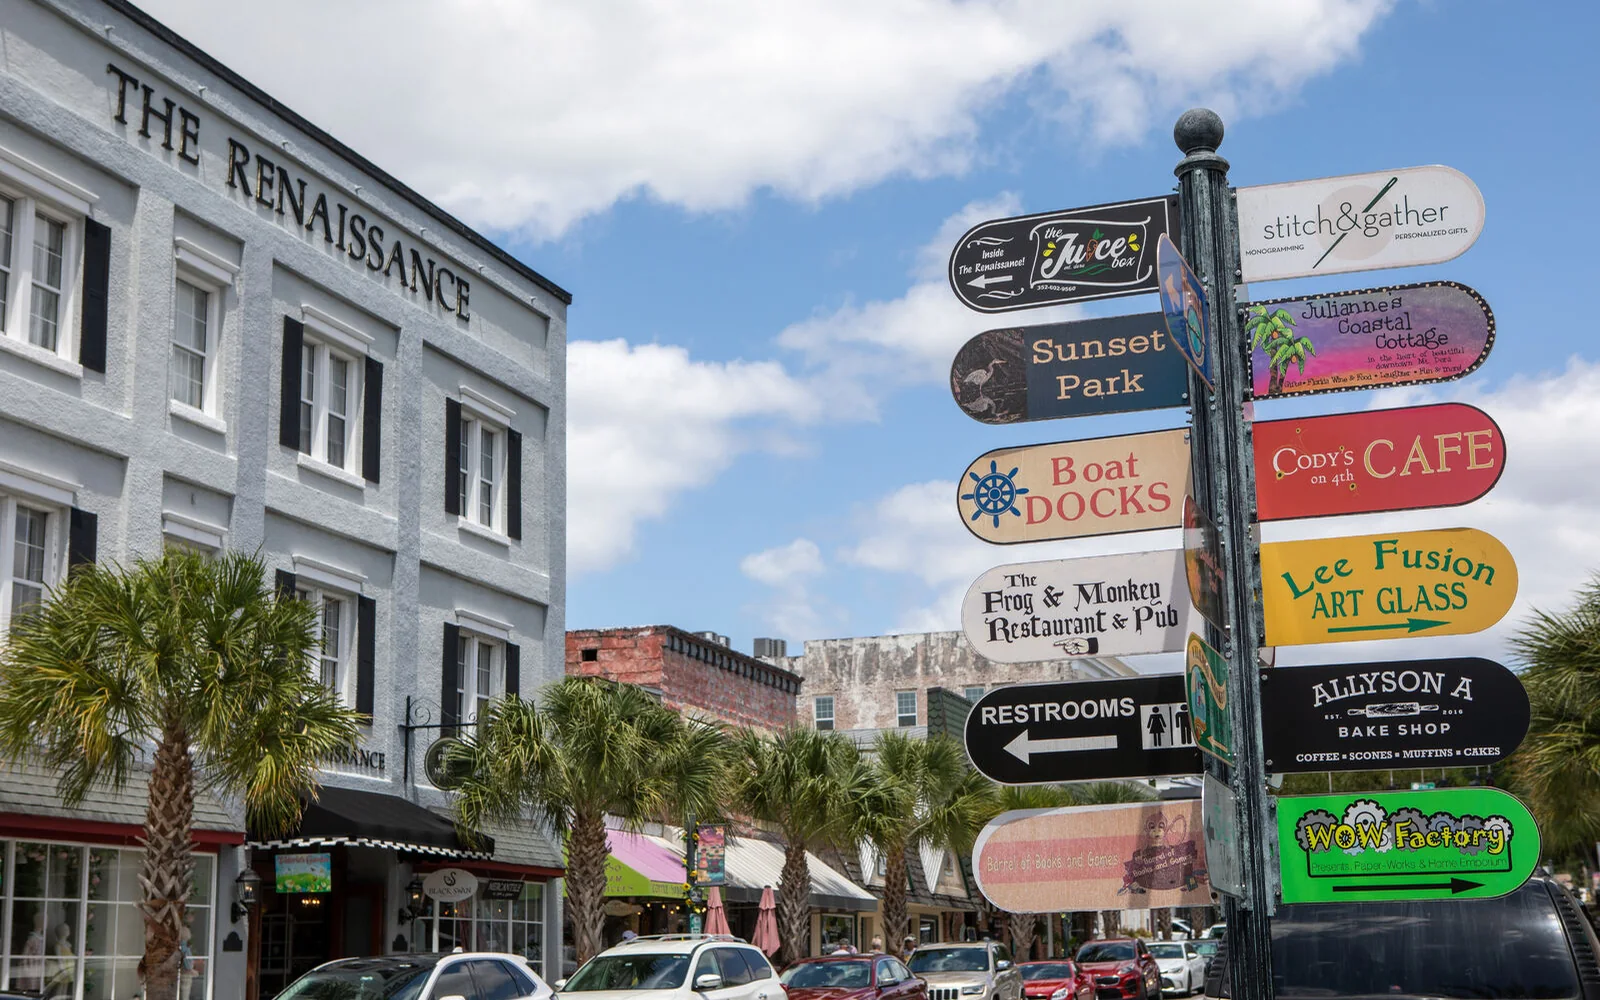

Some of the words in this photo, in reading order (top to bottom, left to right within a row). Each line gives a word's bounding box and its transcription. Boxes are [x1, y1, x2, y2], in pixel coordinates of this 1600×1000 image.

[106, 62, 201, 166] THE
[226, 136, 471, 322] RENAISSANCE
[1044, 226, 1064, 240] the
[1394, 229, 1448, 241] PERSONALIZED
[1447, 227, 1468, 236] GIFTS
[982, 248, 1005, 260] Inside
[1245, 244, 1305, 256] MONOGRAMMING
[959, 264, 973, 276] The
[974, 256, 1026, 274] Renaissance!
[1111, 255, 1136, 269] box
[1301, 293, 1403, 320] Julianne's
[1338, 312, 1413, 335] Coastal
[1032, 330, 1166, 364] Sunset
[1375, 327, 1449, 350] Cottage
[1375, 360, 1414, 370] downtown
[1056, 369, 1144, 400] Park
[1363, 428, 1495, 479] CAFE
[1050, 451, 1140, 487] Boat
[1310, 473, 1328, 485] on
[1331, 469, 1355, 487] 4th
[1025, 482, 1171, 525] DOCKS
[1281, 558, 1354, 600] Lee
[1372, 538, 1496, 586] Fusion
[1003, 573, 1038, 589] The
[981, 589, 1034, 616] Frog
[1042, 585, 1064, 609] &
[1072, 578, 1163, 612] Monkey
[1311, 589, 1364, 619] ART
[1376, 582, 1468, 615] GLASS
[984, 609, 1107, 644] Restaurant
[1112, 612, 1129, 630] &
[1132, 603, 1179, 636] Pub
[1312, 670, 1446, 708] ALLYSON
[1450, 676, 1474, 702] A
[981, 697, 1136, 726] RESTROOMS
[1324, 713, 1343, 721] EST.
[1338, 725, 1390, 738] BAKE
[1398, 722, 1451, 736] SHOP
[1296, 752, 1340, 763] COFFEE
[1349, 750, 1393, 761] SCONES
[1402, 748, 1454, 760] MUFFINS
[1463, 746, 1501, 757] CAKES
[1304, 822, 1387, 851] WOW
[1395, 818, 1506, 855] Factory
[987, 855, 1017, 872] Barrel
[1034, 853, 1063, 869] Books
[1066, 852, 1083, 869] and
[1087, 850, 1119, 867] Games
[1428, 857, 1457, 869] Home
[1459, 857, 1507, 867] Emporium
